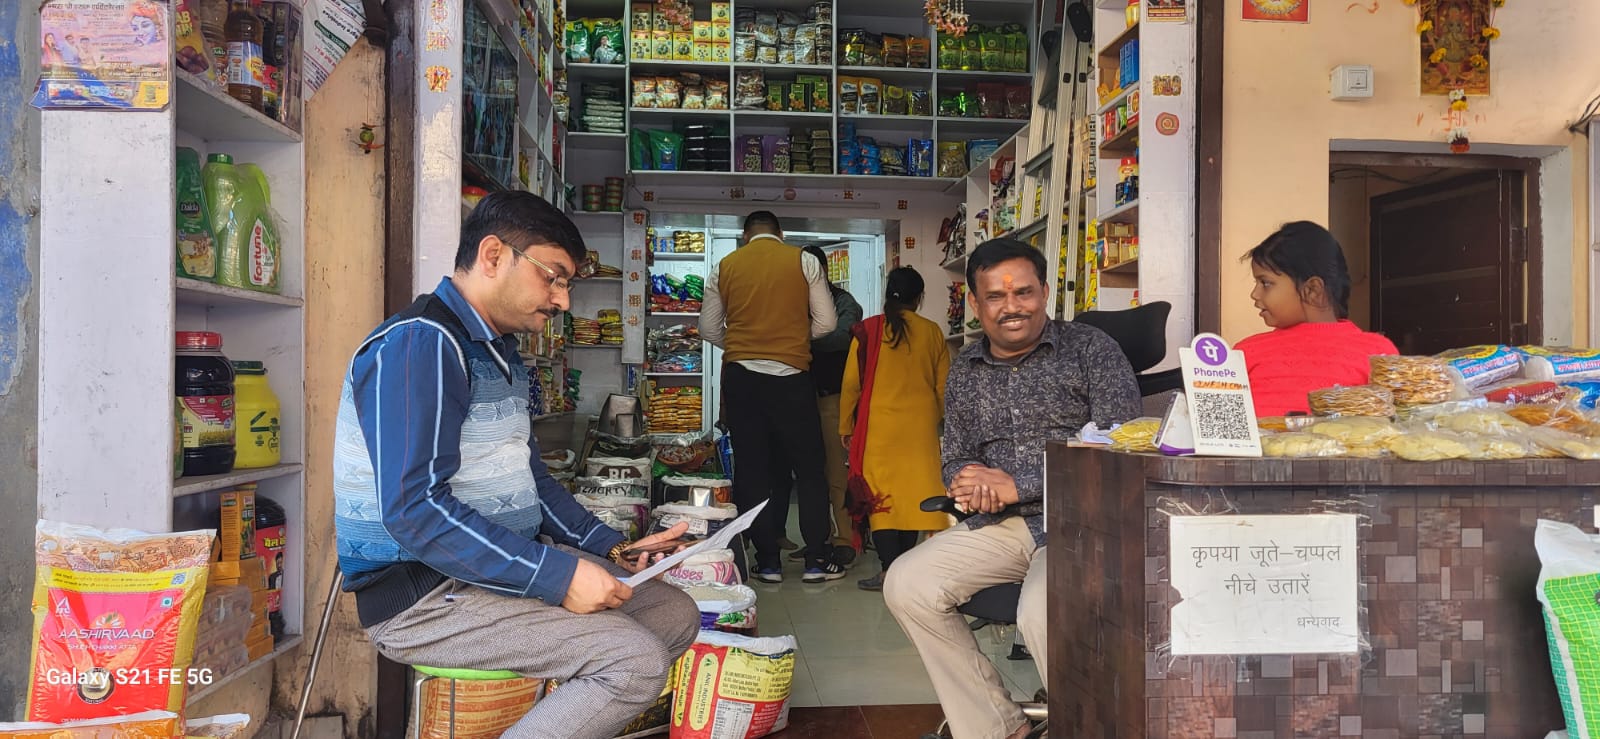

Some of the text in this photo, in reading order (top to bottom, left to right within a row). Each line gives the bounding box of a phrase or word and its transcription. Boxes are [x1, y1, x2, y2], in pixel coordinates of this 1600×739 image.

[253, 225, 263, 282] fortune
[1202, 340, 1218, 362] पे
[1193, 367, 1236, 378] PhonePe
[1190, 546, 1240, 568] कृपया
[669, 568, 704, 581] ulses
[1223, 572, 1310, 595] नीचे उतारें
[1296, 617, 1341, 628] धन्यवाद
[58, 628, 155, 641] AASHIRVAAD
[697, 687, 709, 724] INDUSTRIES
